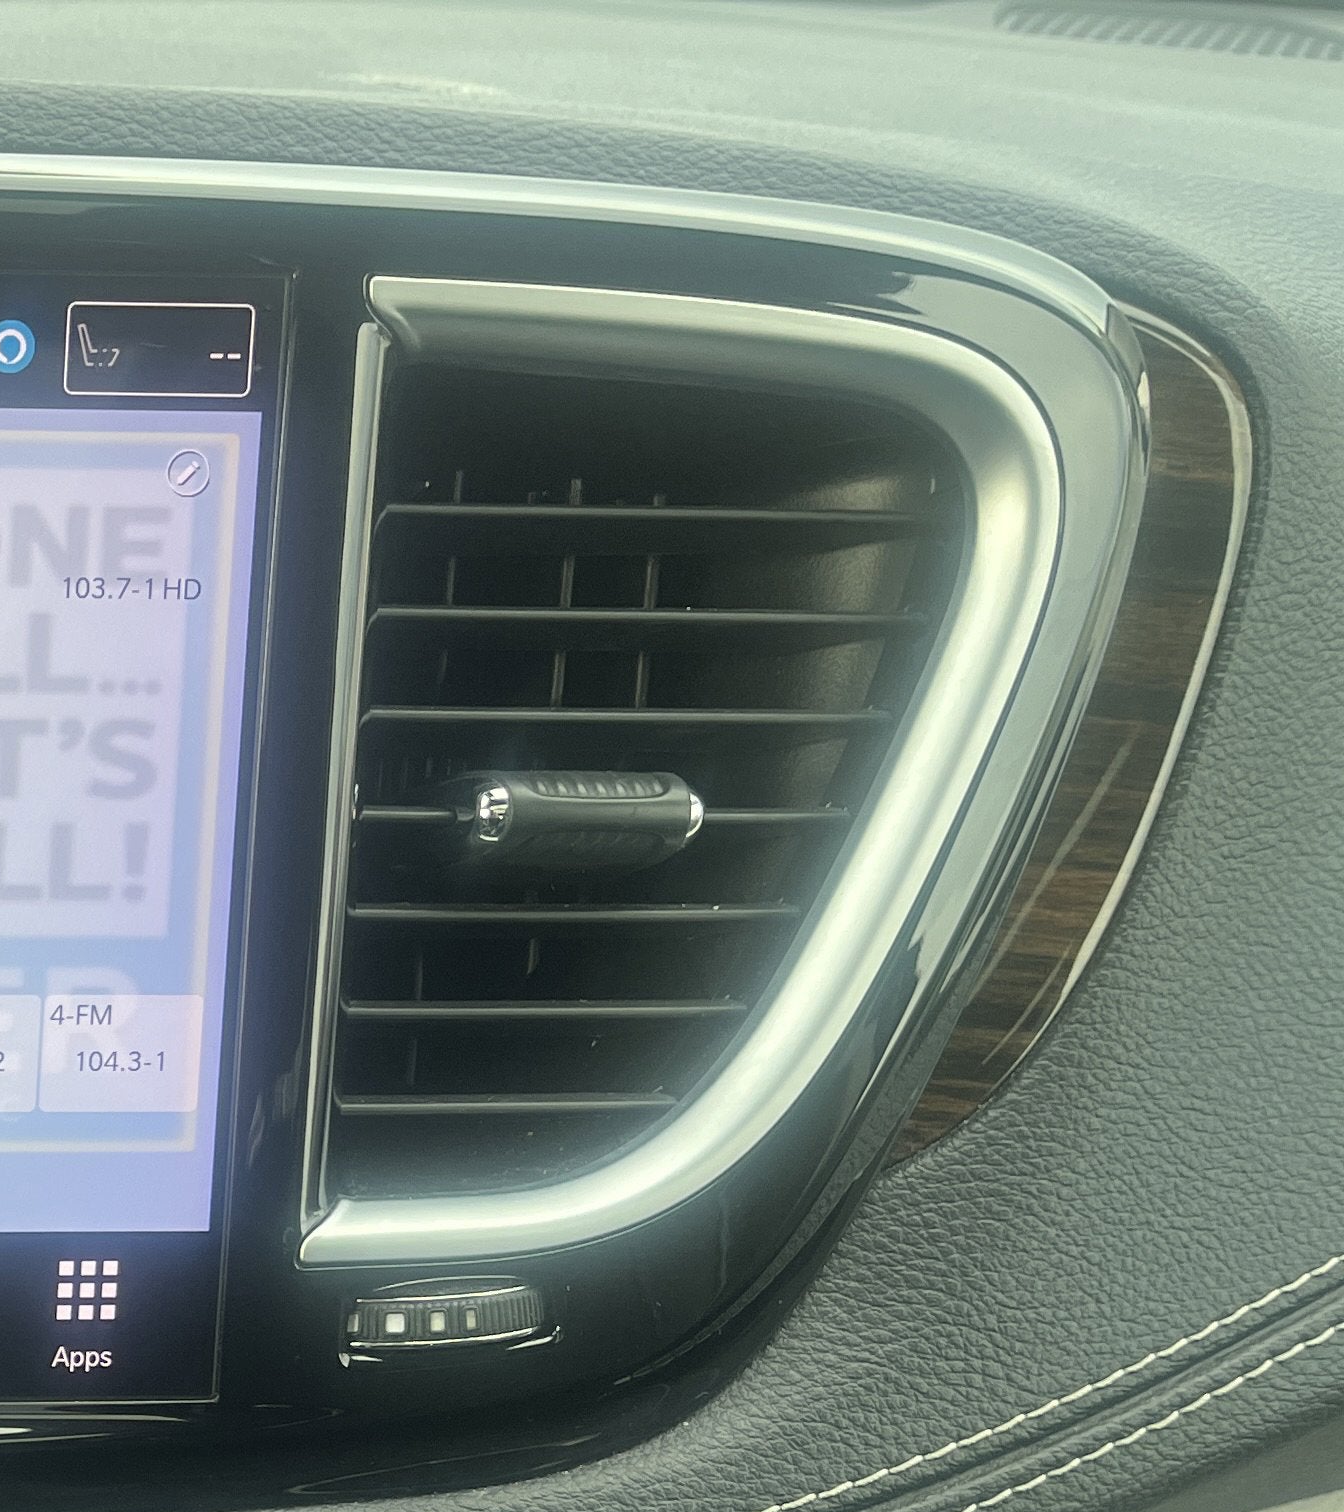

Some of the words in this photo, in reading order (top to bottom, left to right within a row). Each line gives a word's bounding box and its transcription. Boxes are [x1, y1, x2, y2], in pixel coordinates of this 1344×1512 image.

[63, 576, 155, 601] 103.7-1
[163, 577, 202, 601] HD
[49, 1003, 114, 1028] 4-FM
[75, 1049, 167, 1074] 104.3-1
[51, 1344, 114, 1373] Apps
